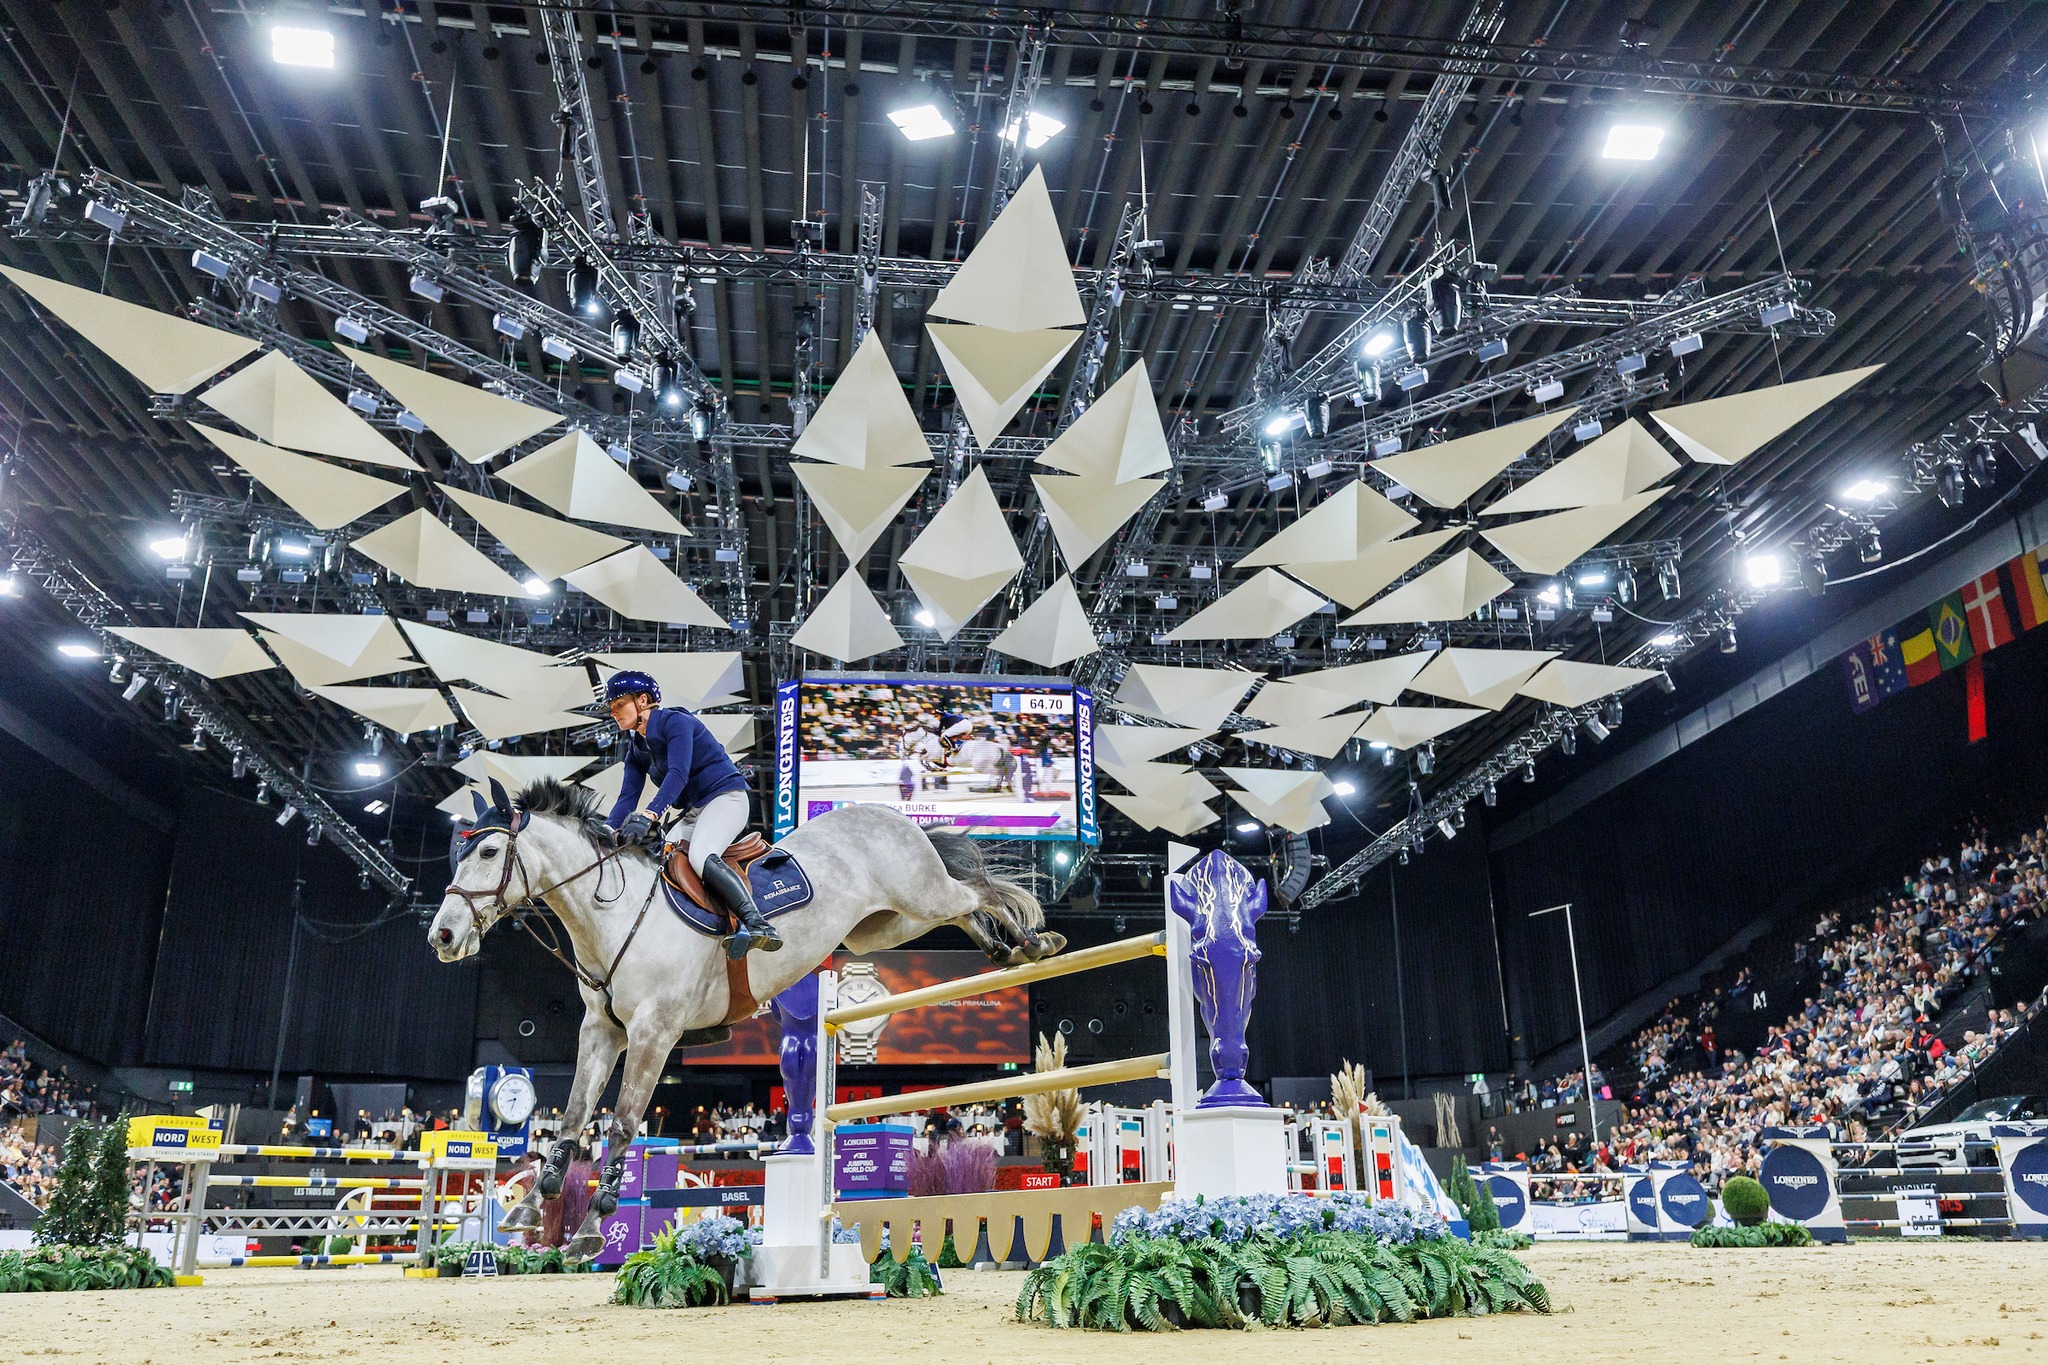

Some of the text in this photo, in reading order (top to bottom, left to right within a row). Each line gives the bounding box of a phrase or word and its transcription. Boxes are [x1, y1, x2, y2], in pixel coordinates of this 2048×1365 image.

[1002, 697, 1063, 710] 4 64.70
[778, 697, 795, 824] LONGINES
[1079, 703, 1094, 828] LONGINES
[905, 804, 937, 812] BURKE
[763, 884, 802, 900] RENAISSANCE
[1753, 991, 1767, 1010] A1
[155, 1132, 218, 1144] NORD WEST
[497, 1136, 524, 1145] NGINES
[843, 1138, 877, 1146] LONGINES
[448, 1144, 495, 1155] NORD WEST
[843, 1166, 864, 1174] WORLD
[1026, 1176, 1054, 1187] START
[1773, 1175, 1819, 1185] LONGINES
[294, 1188, 305, 1196] LES
[721, 1191, 750, 1202] BASEL
[472, 1253, 477, 1264] 1
[485, 1253, 490, 1264] 1
